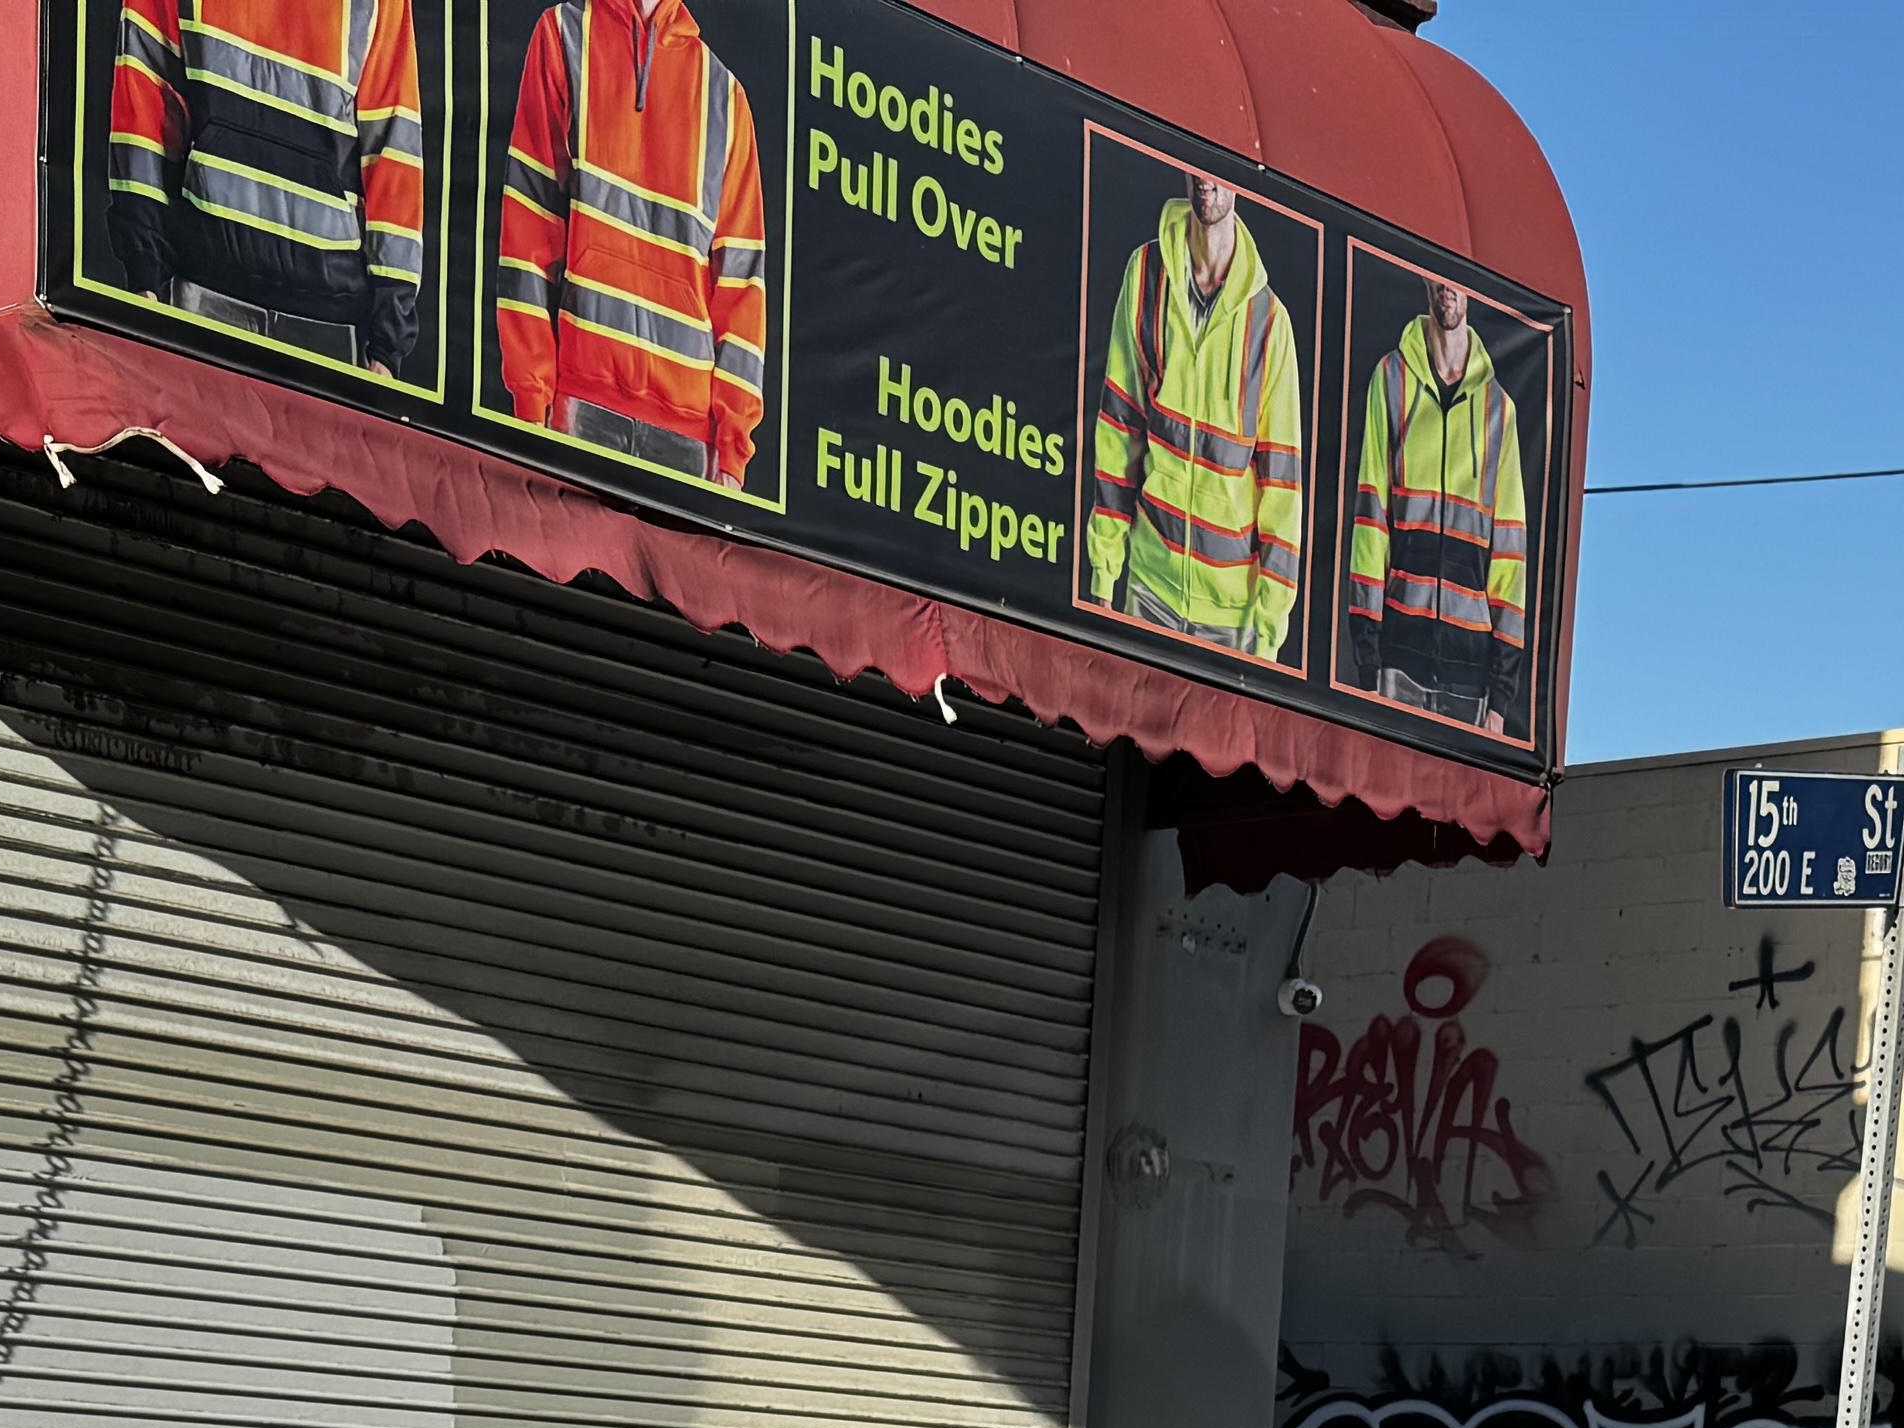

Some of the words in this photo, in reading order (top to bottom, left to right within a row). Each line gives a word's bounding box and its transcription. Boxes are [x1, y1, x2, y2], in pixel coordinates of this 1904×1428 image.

[810, 35, 1004, 176] Hoodies
[808, 129, 899, 222] Pull
[911, 176, 1024, 270] Over
[877, 355, 1065, 477] Hoodies
[815, 429, 902, 515] Full
[913, 462, 1065, 565] Zipper
[1742, 850, 1791, 896] 200
[1800, 851, 1816, 895] E
[1747, 780, 1798, 848] 15th
[1862, 784, 1898, 850] St
